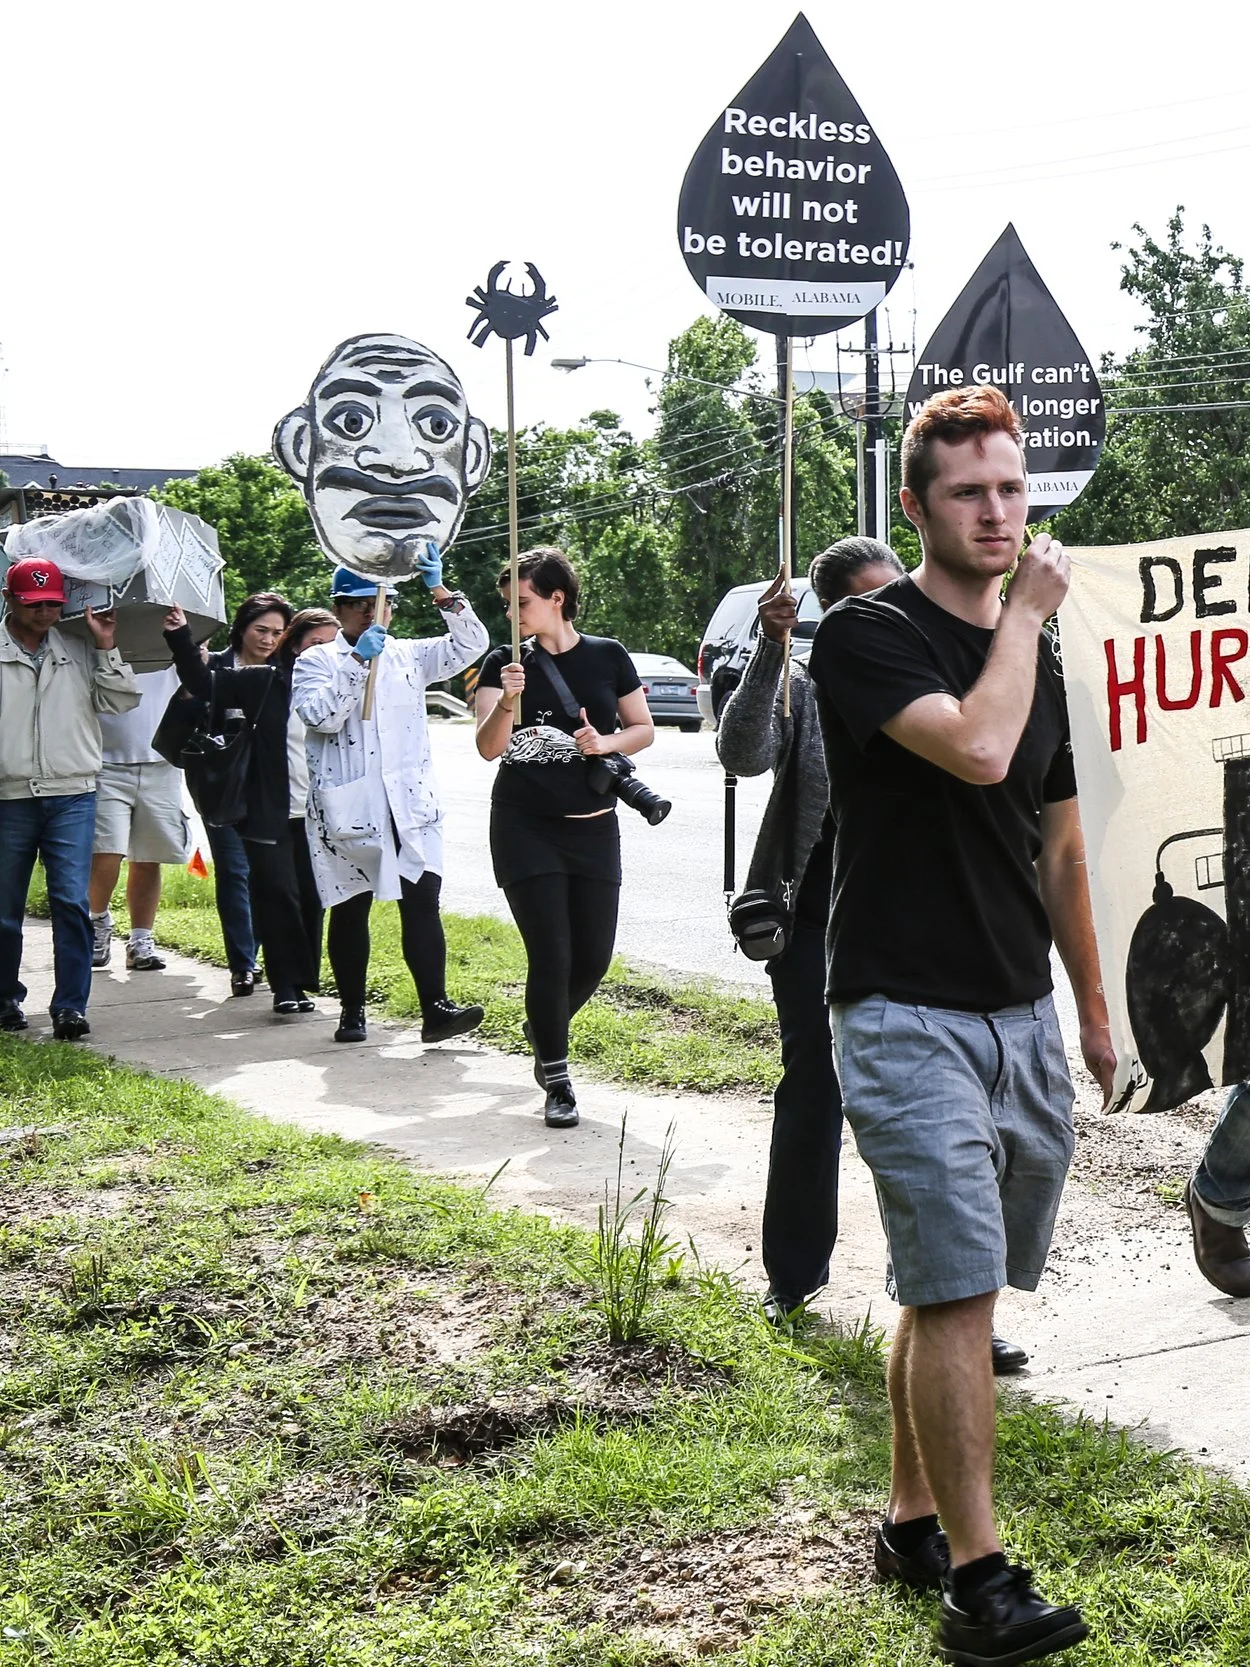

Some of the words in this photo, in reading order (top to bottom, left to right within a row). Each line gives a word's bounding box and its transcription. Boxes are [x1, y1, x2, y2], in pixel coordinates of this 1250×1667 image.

[724, 107, 872, 145] Reckless
[721, 147, 872, 185] behavior
[731, 191, 791, 219] will
[802, 199, 858, 225] not
[683, 226, 726, 255] be
[737, 232, 903, 266] tolerated!
[792, 291, 861, 304] ALABAMA
[918, 363, 964, 385] The
[972, 362, 1025, 385] Gulf
[1031, 362, 1091, 384] can't
[1022, 395, 1100, 422] longer
[1020, 426, 1098, 448] ration.
[1027, 481, 1079, 493] LABAMA
